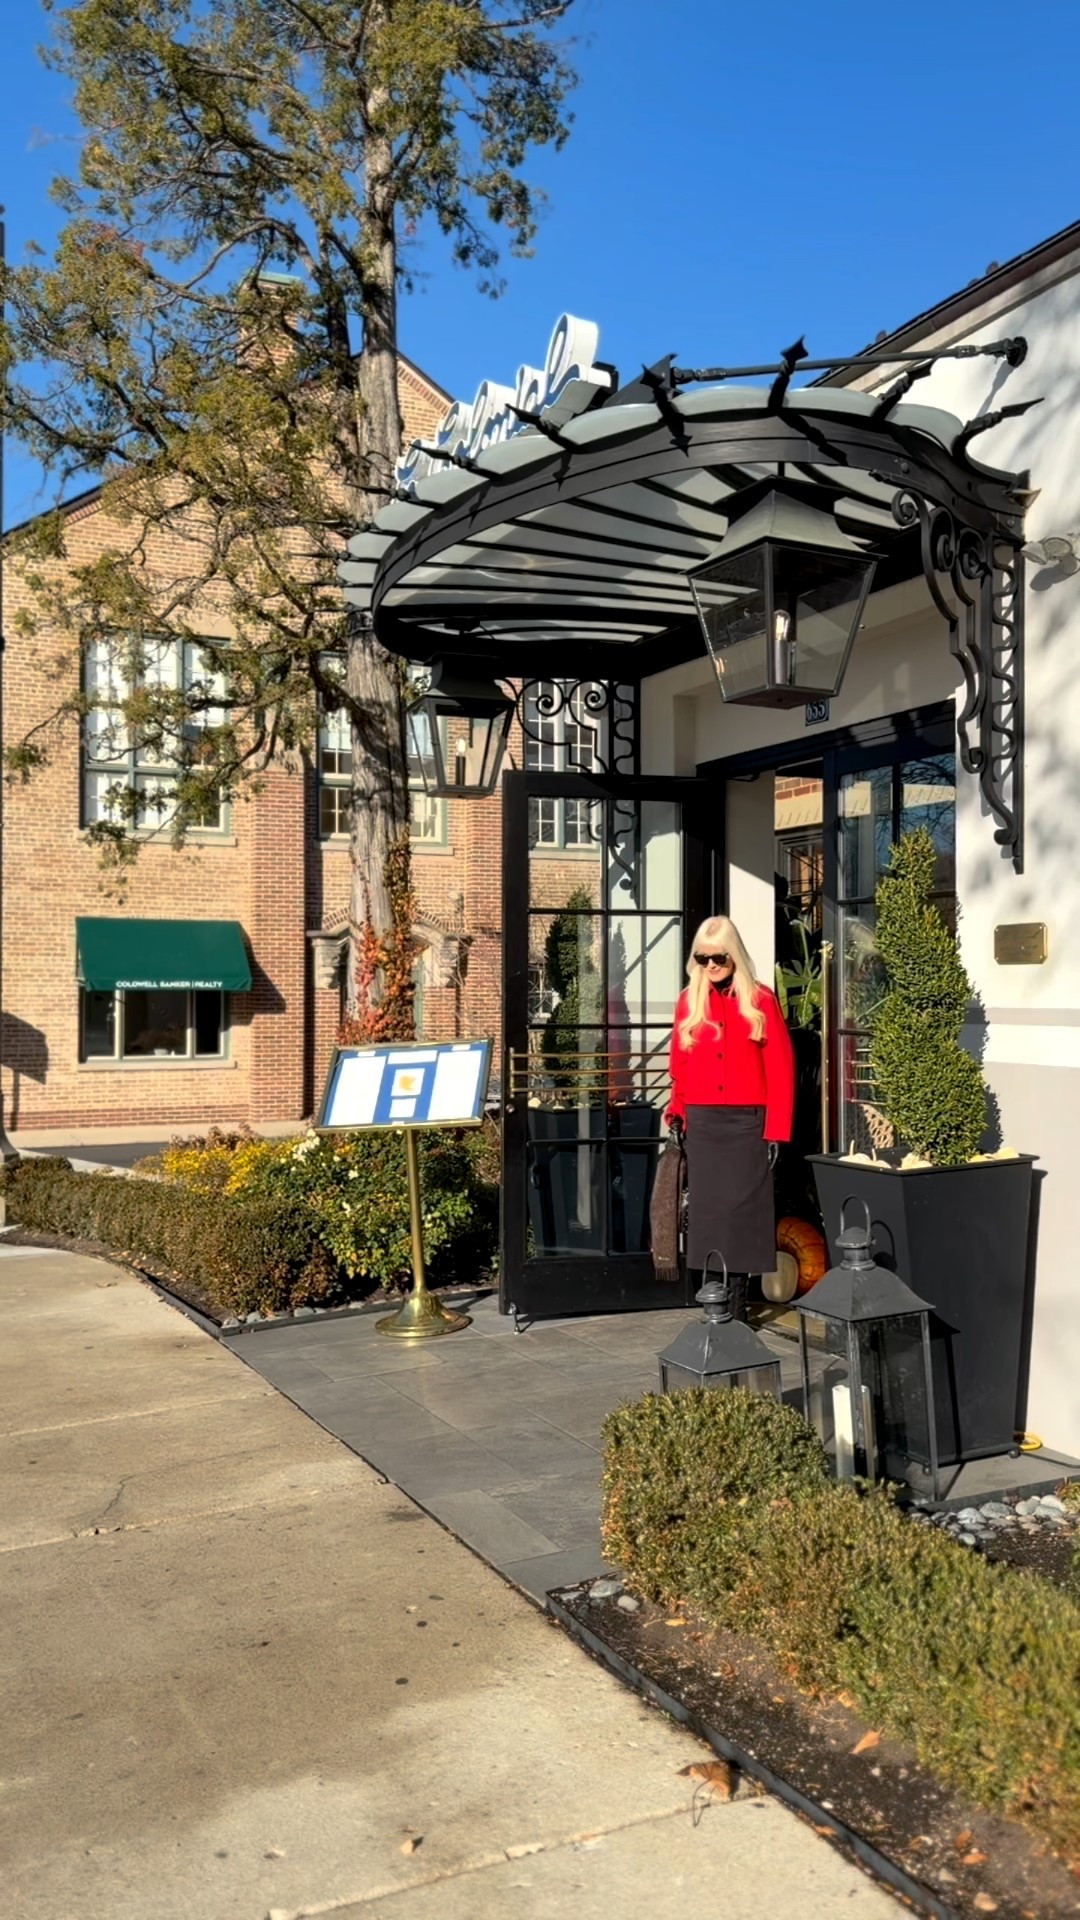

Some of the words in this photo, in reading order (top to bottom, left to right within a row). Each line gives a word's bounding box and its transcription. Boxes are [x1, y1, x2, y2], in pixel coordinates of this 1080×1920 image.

[806, 700, 826, 720] 655
[116, 980, 158, 988] COLDWELL
[159, 980, 191, 988] BANKER
[194, 980, 223, 988] REALTY
